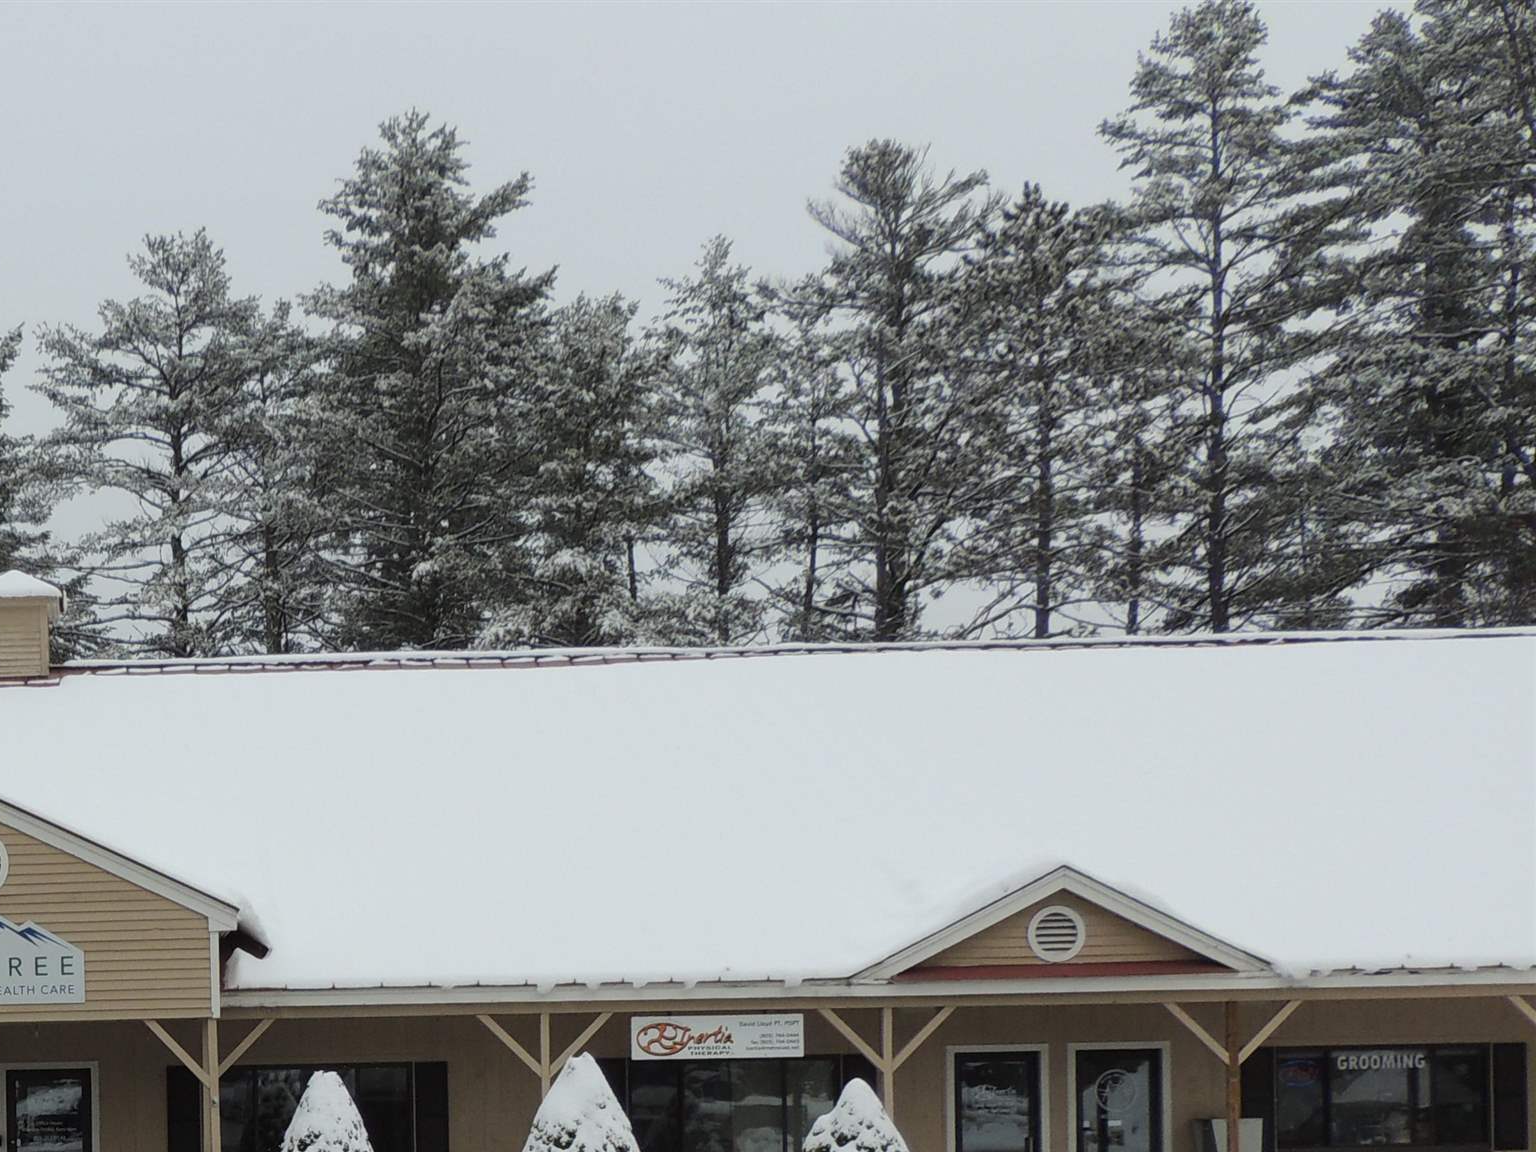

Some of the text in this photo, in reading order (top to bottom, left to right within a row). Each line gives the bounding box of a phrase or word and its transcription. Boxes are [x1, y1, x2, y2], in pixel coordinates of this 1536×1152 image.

[40, 984, 76, 995] CARE
[674, 1024, 734, 1045] Inertia
[1336, 1054, 1426, 1070] GROOMING
